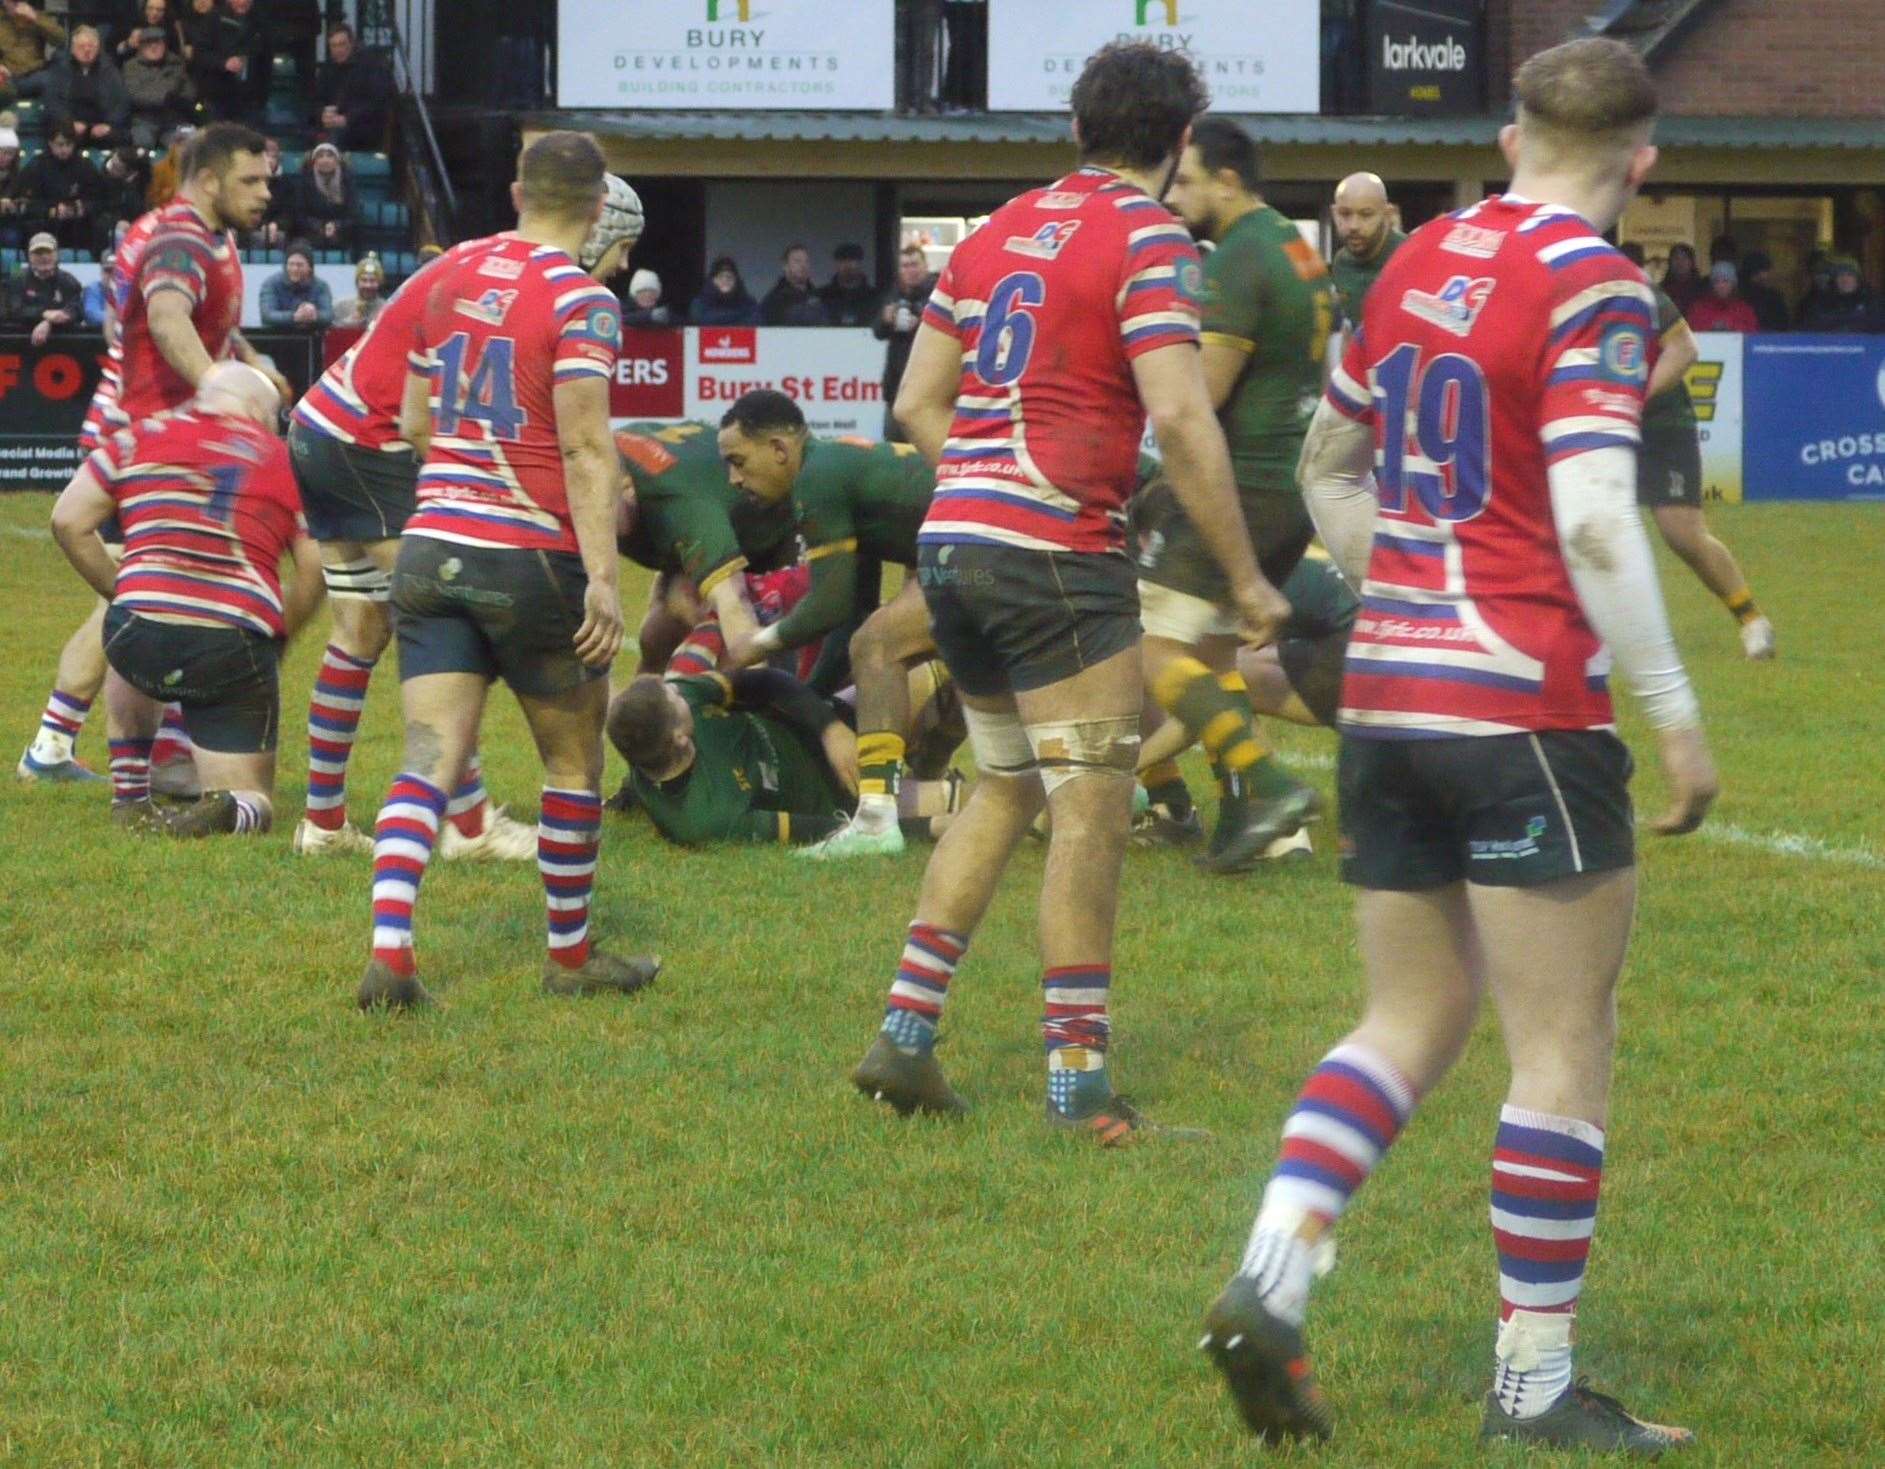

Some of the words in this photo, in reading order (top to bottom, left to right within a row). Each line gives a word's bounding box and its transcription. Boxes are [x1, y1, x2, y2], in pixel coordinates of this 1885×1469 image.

[686, 29, 765, 48] BURY
[613, 55, 839, 71] DEVELOPMENTS
[1383, 34, 1466, 70] larkvale
[617, 80, 699, 94] BUILDING
[706, 80, 836, 94] CONTRACTORS
[976, 271, 1046, 388] 6
[431, 331, 527, 443] 14
[781, 376, 814, 401] St
[1366, 343, 1493, 522] 19
[35, 447, 75, 459] Media
